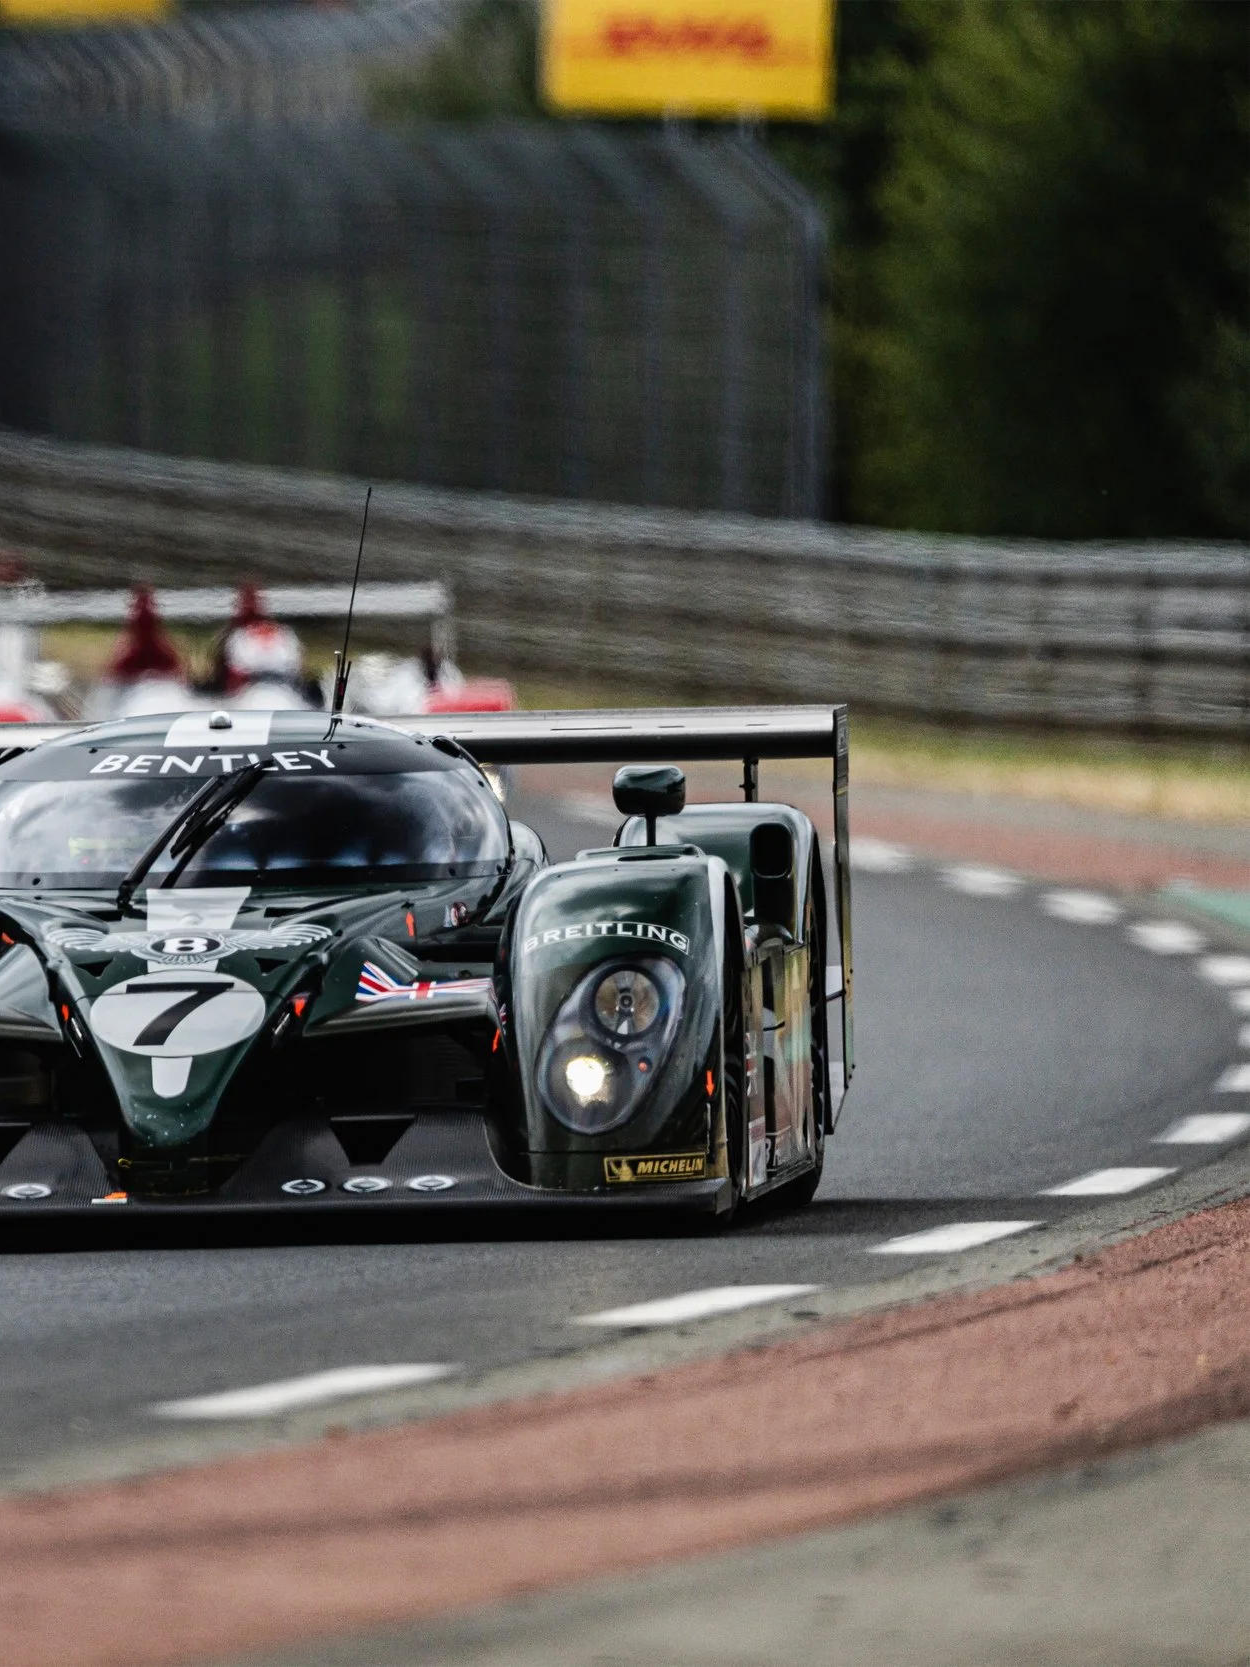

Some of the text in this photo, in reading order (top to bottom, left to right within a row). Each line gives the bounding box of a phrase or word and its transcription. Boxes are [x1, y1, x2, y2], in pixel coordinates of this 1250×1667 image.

[162, 936, 208, 954] B
[523, 922, 688, 952] BREITLING
[126, 982, 235, 1046] 7
[636, 1158, 704, 1175] MICHELIN
